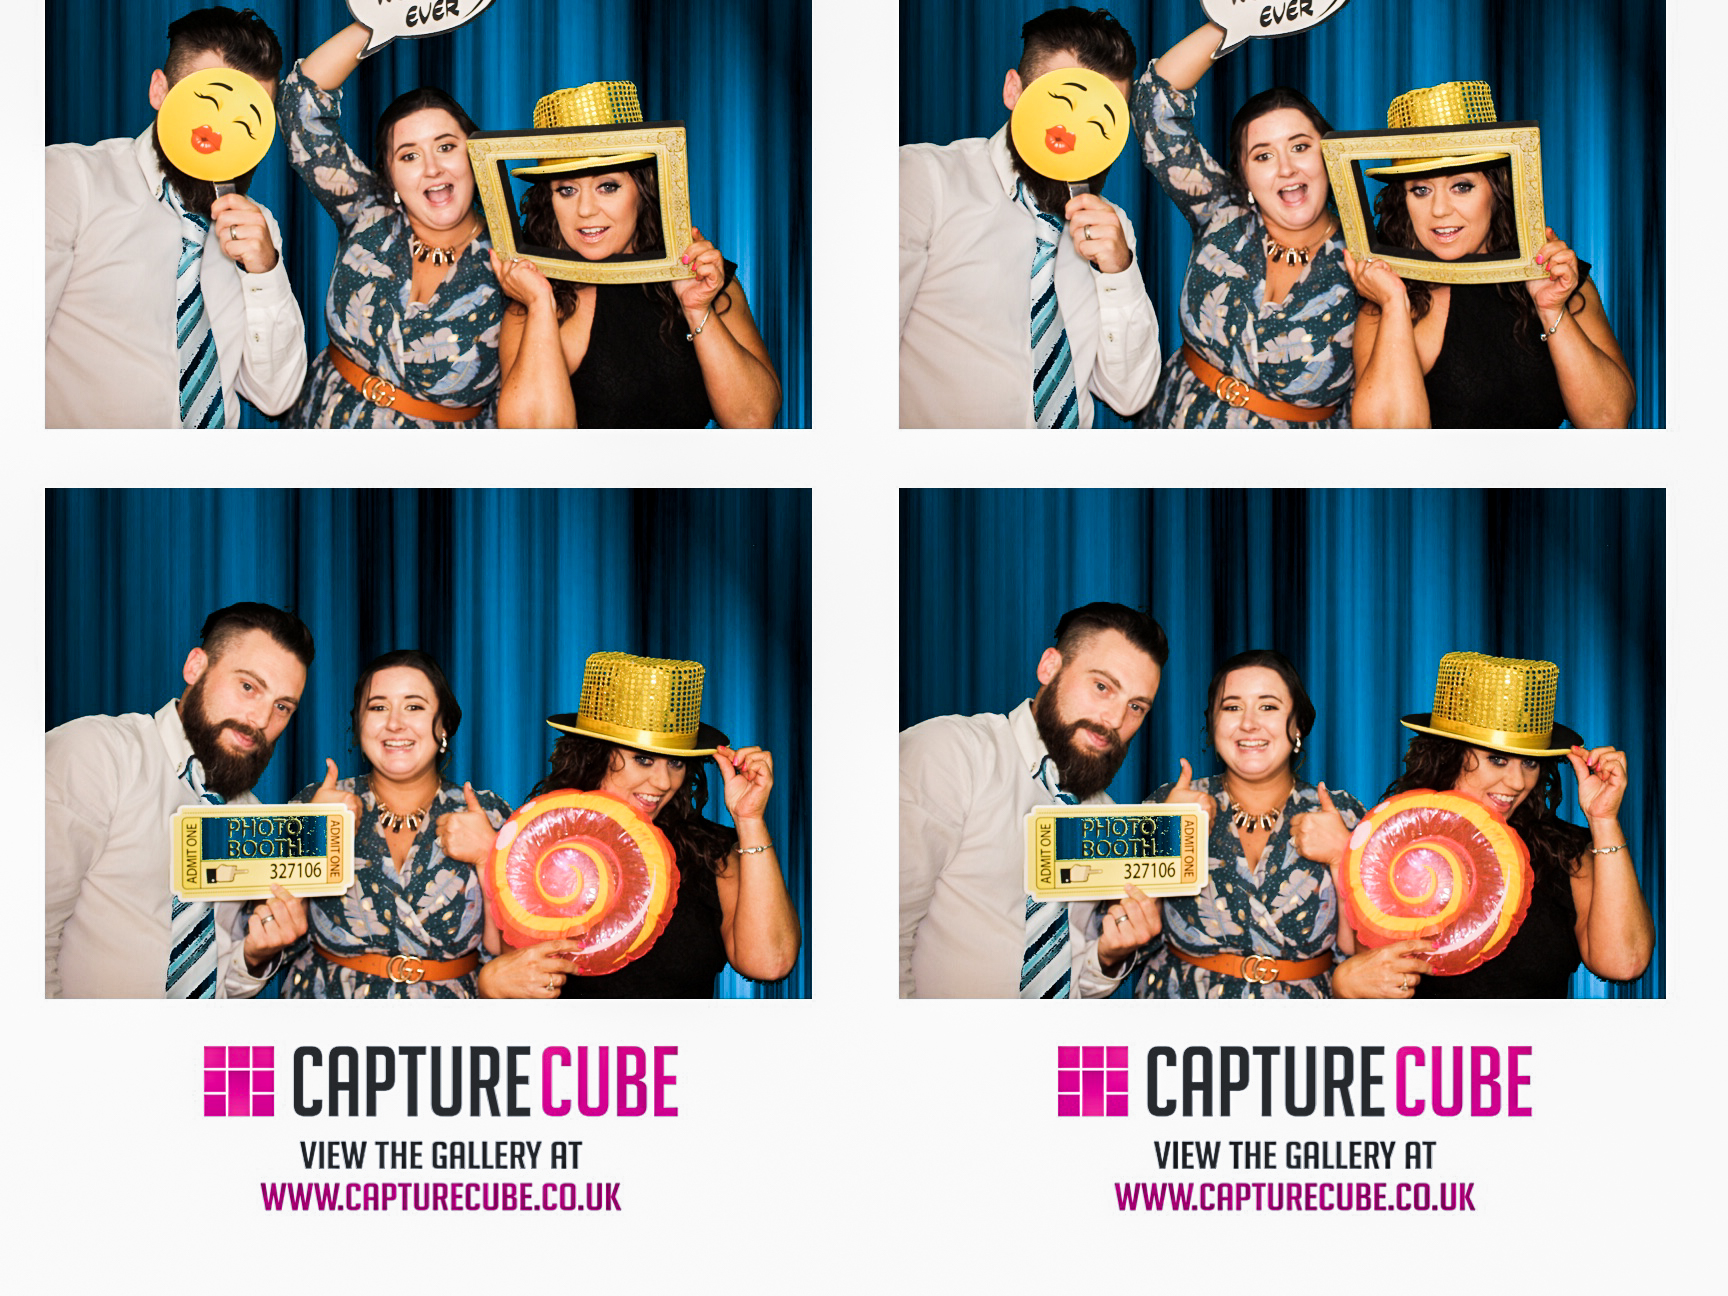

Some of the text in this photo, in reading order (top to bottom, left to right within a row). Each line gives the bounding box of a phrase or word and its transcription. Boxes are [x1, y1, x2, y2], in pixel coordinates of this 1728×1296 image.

[227, 818, 303, 838] PHOTO
[1081, 818, 1157, 838] PHOTO
[186, 823, 197, 884] ADMIT ONE
[227, 838, 302, 857] BOOTH
[329, 819, 340, 878] ADMIT ONE
[1040, 823, 1051, 884] ADMIT ONE
[1081, 838, 1156, 857] BOOTH
[1183, 819, 1194, 878] ADMIT ONE
[270, 862, 322, 880] 327106
[1124, 862, 1176, 880] 327106
